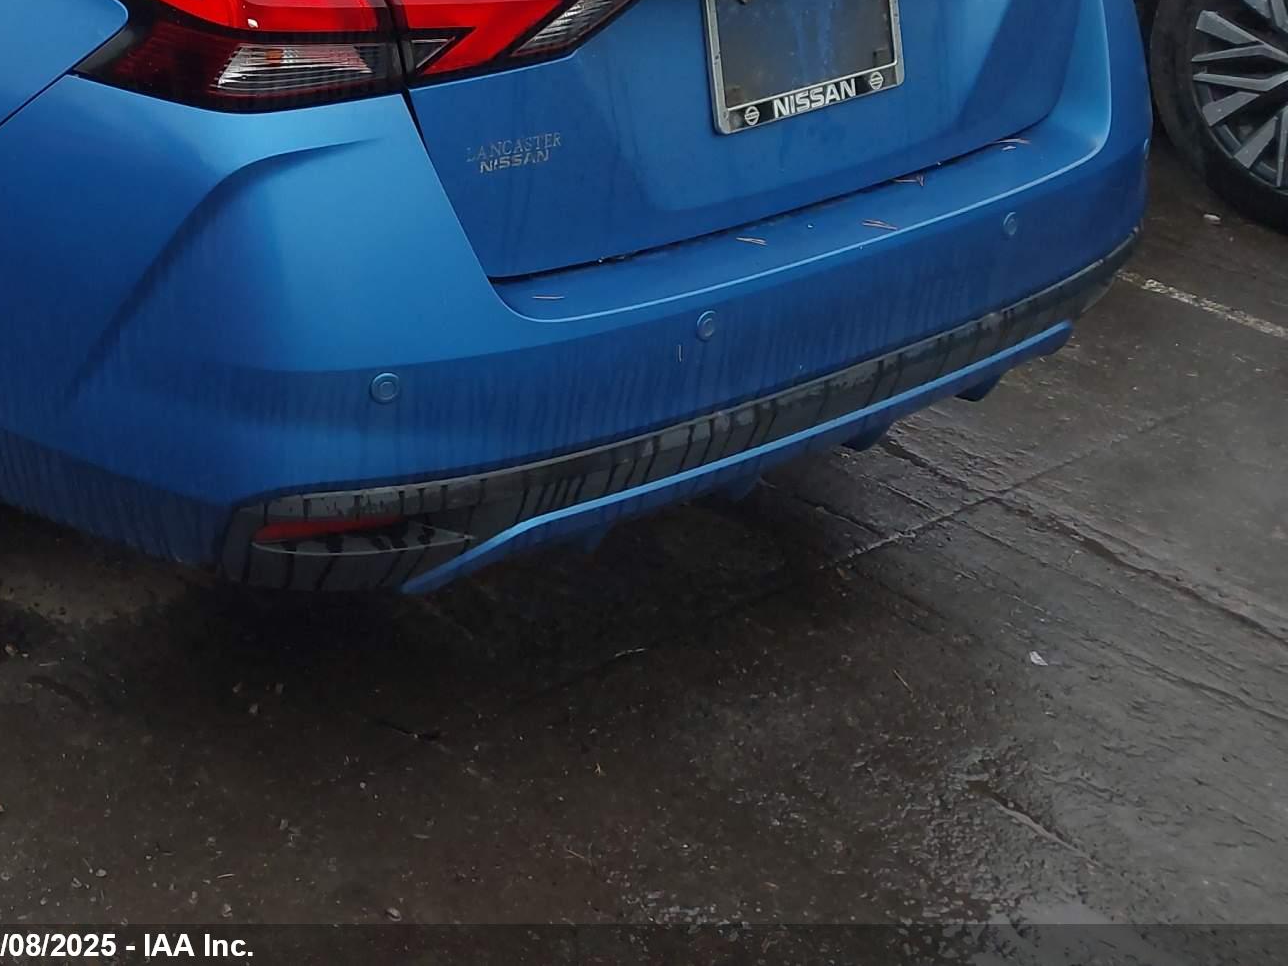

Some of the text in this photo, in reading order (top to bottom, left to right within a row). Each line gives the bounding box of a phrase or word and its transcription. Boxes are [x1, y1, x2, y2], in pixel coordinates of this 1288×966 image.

[773, 78, 856, 119] NISSAN
[466, 132, 561, 163] LANCASTER
[479, 149, 549, 174] NISSAN
